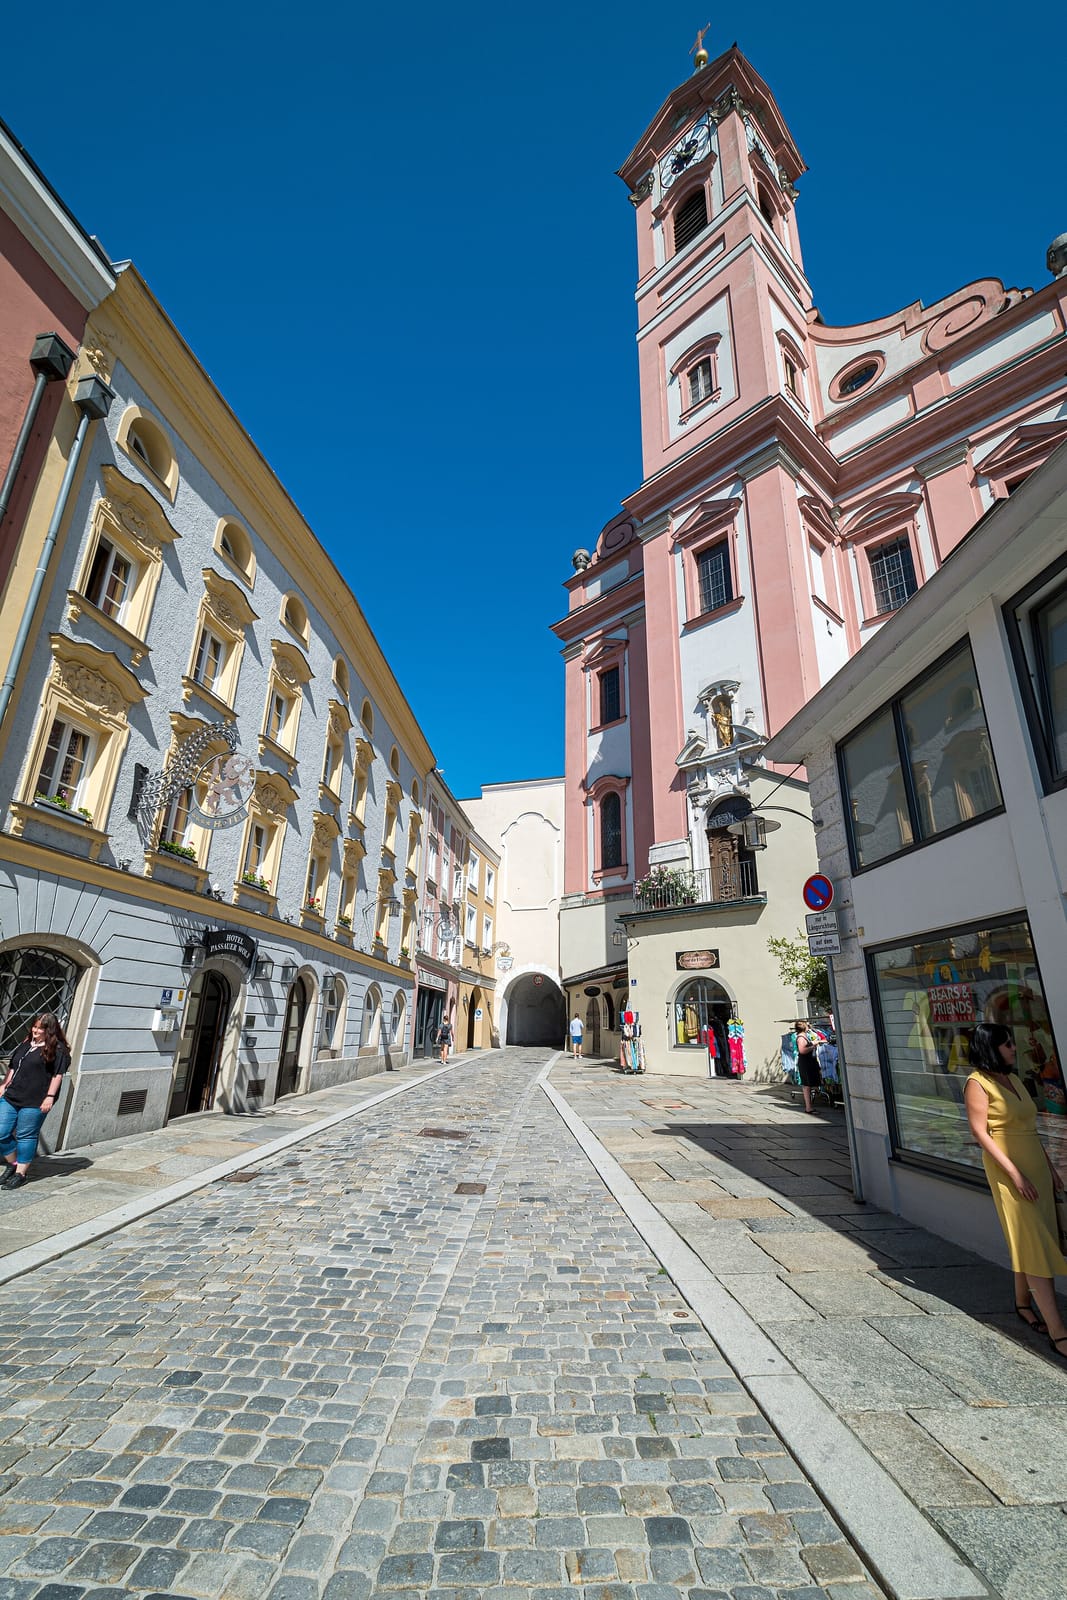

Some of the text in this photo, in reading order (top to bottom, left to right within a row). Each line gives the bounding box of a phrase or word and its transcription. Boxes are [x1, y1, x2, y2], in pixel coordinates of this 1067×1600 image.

[213, 813, 243, 828] HOTEL
[226, 934, 244, 945] HOTEL
[210, 943, 251, 958] PASSAUER WOLF
[930, 985, 970, 1000] BEARS &
[933, 1001, 973, 1015] FRIENDS
